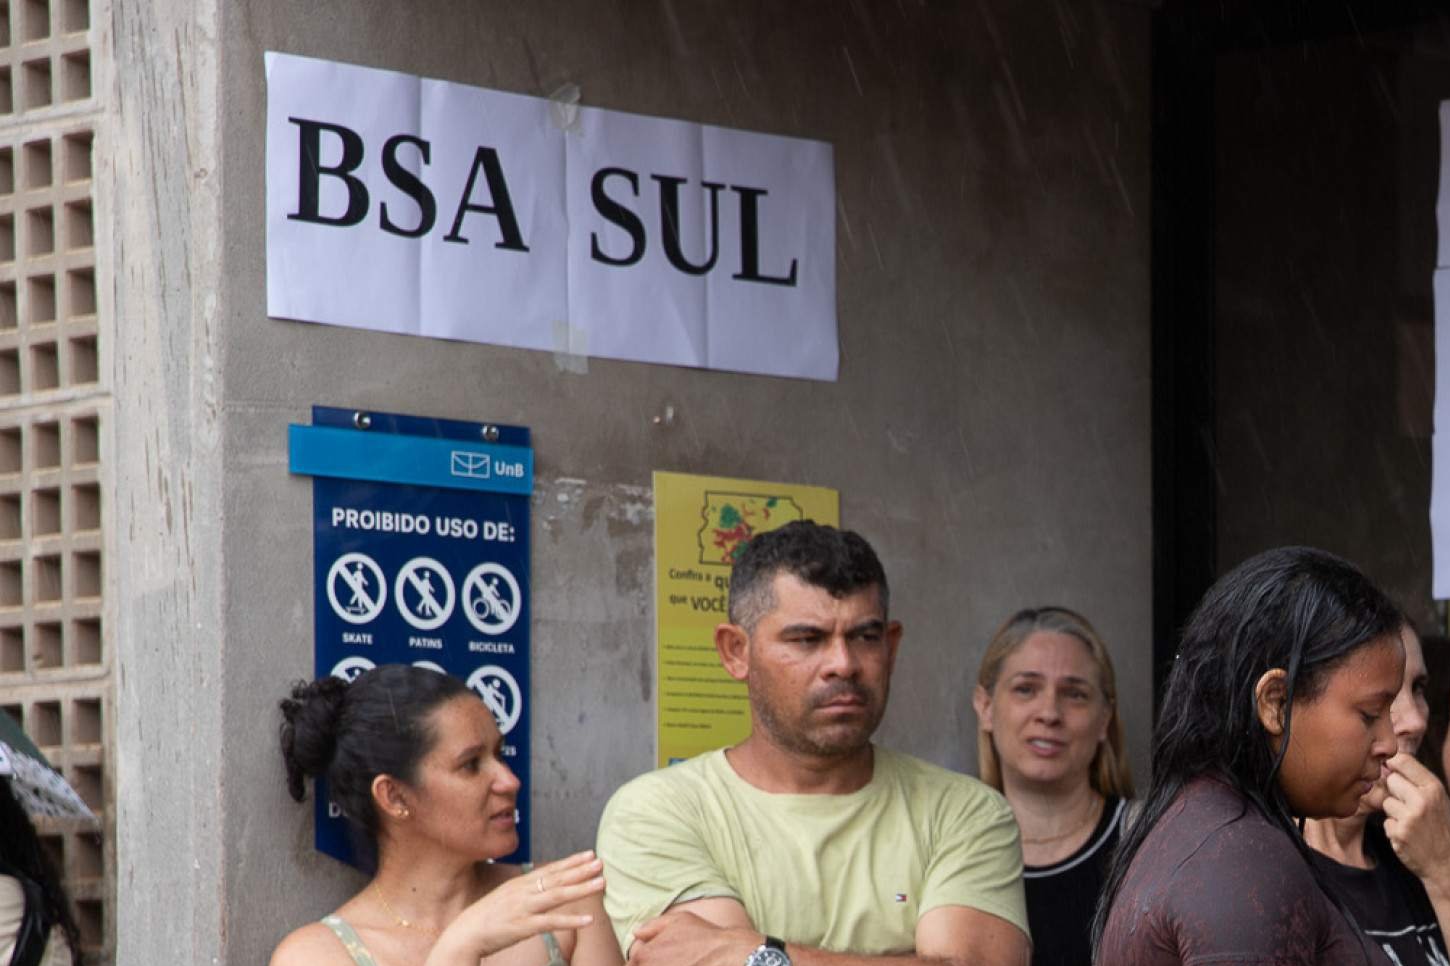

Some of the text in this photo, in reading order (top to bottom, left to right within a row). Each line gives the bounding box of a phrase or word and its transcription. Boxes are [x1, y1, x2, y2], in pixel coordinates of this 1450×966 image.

[287, 117, 797, 286] BSA SUL
[495, 462, 523, 477] UnB
[332, 508, 514, 541] PROIBIDO USO DE:
[691, 595, 725, 612] VOCÊ
[343, 633, 372, 644] SKATE
[409, 638, 442, 648] PATINS
[469, 642, 514, 652] BICICLETA
